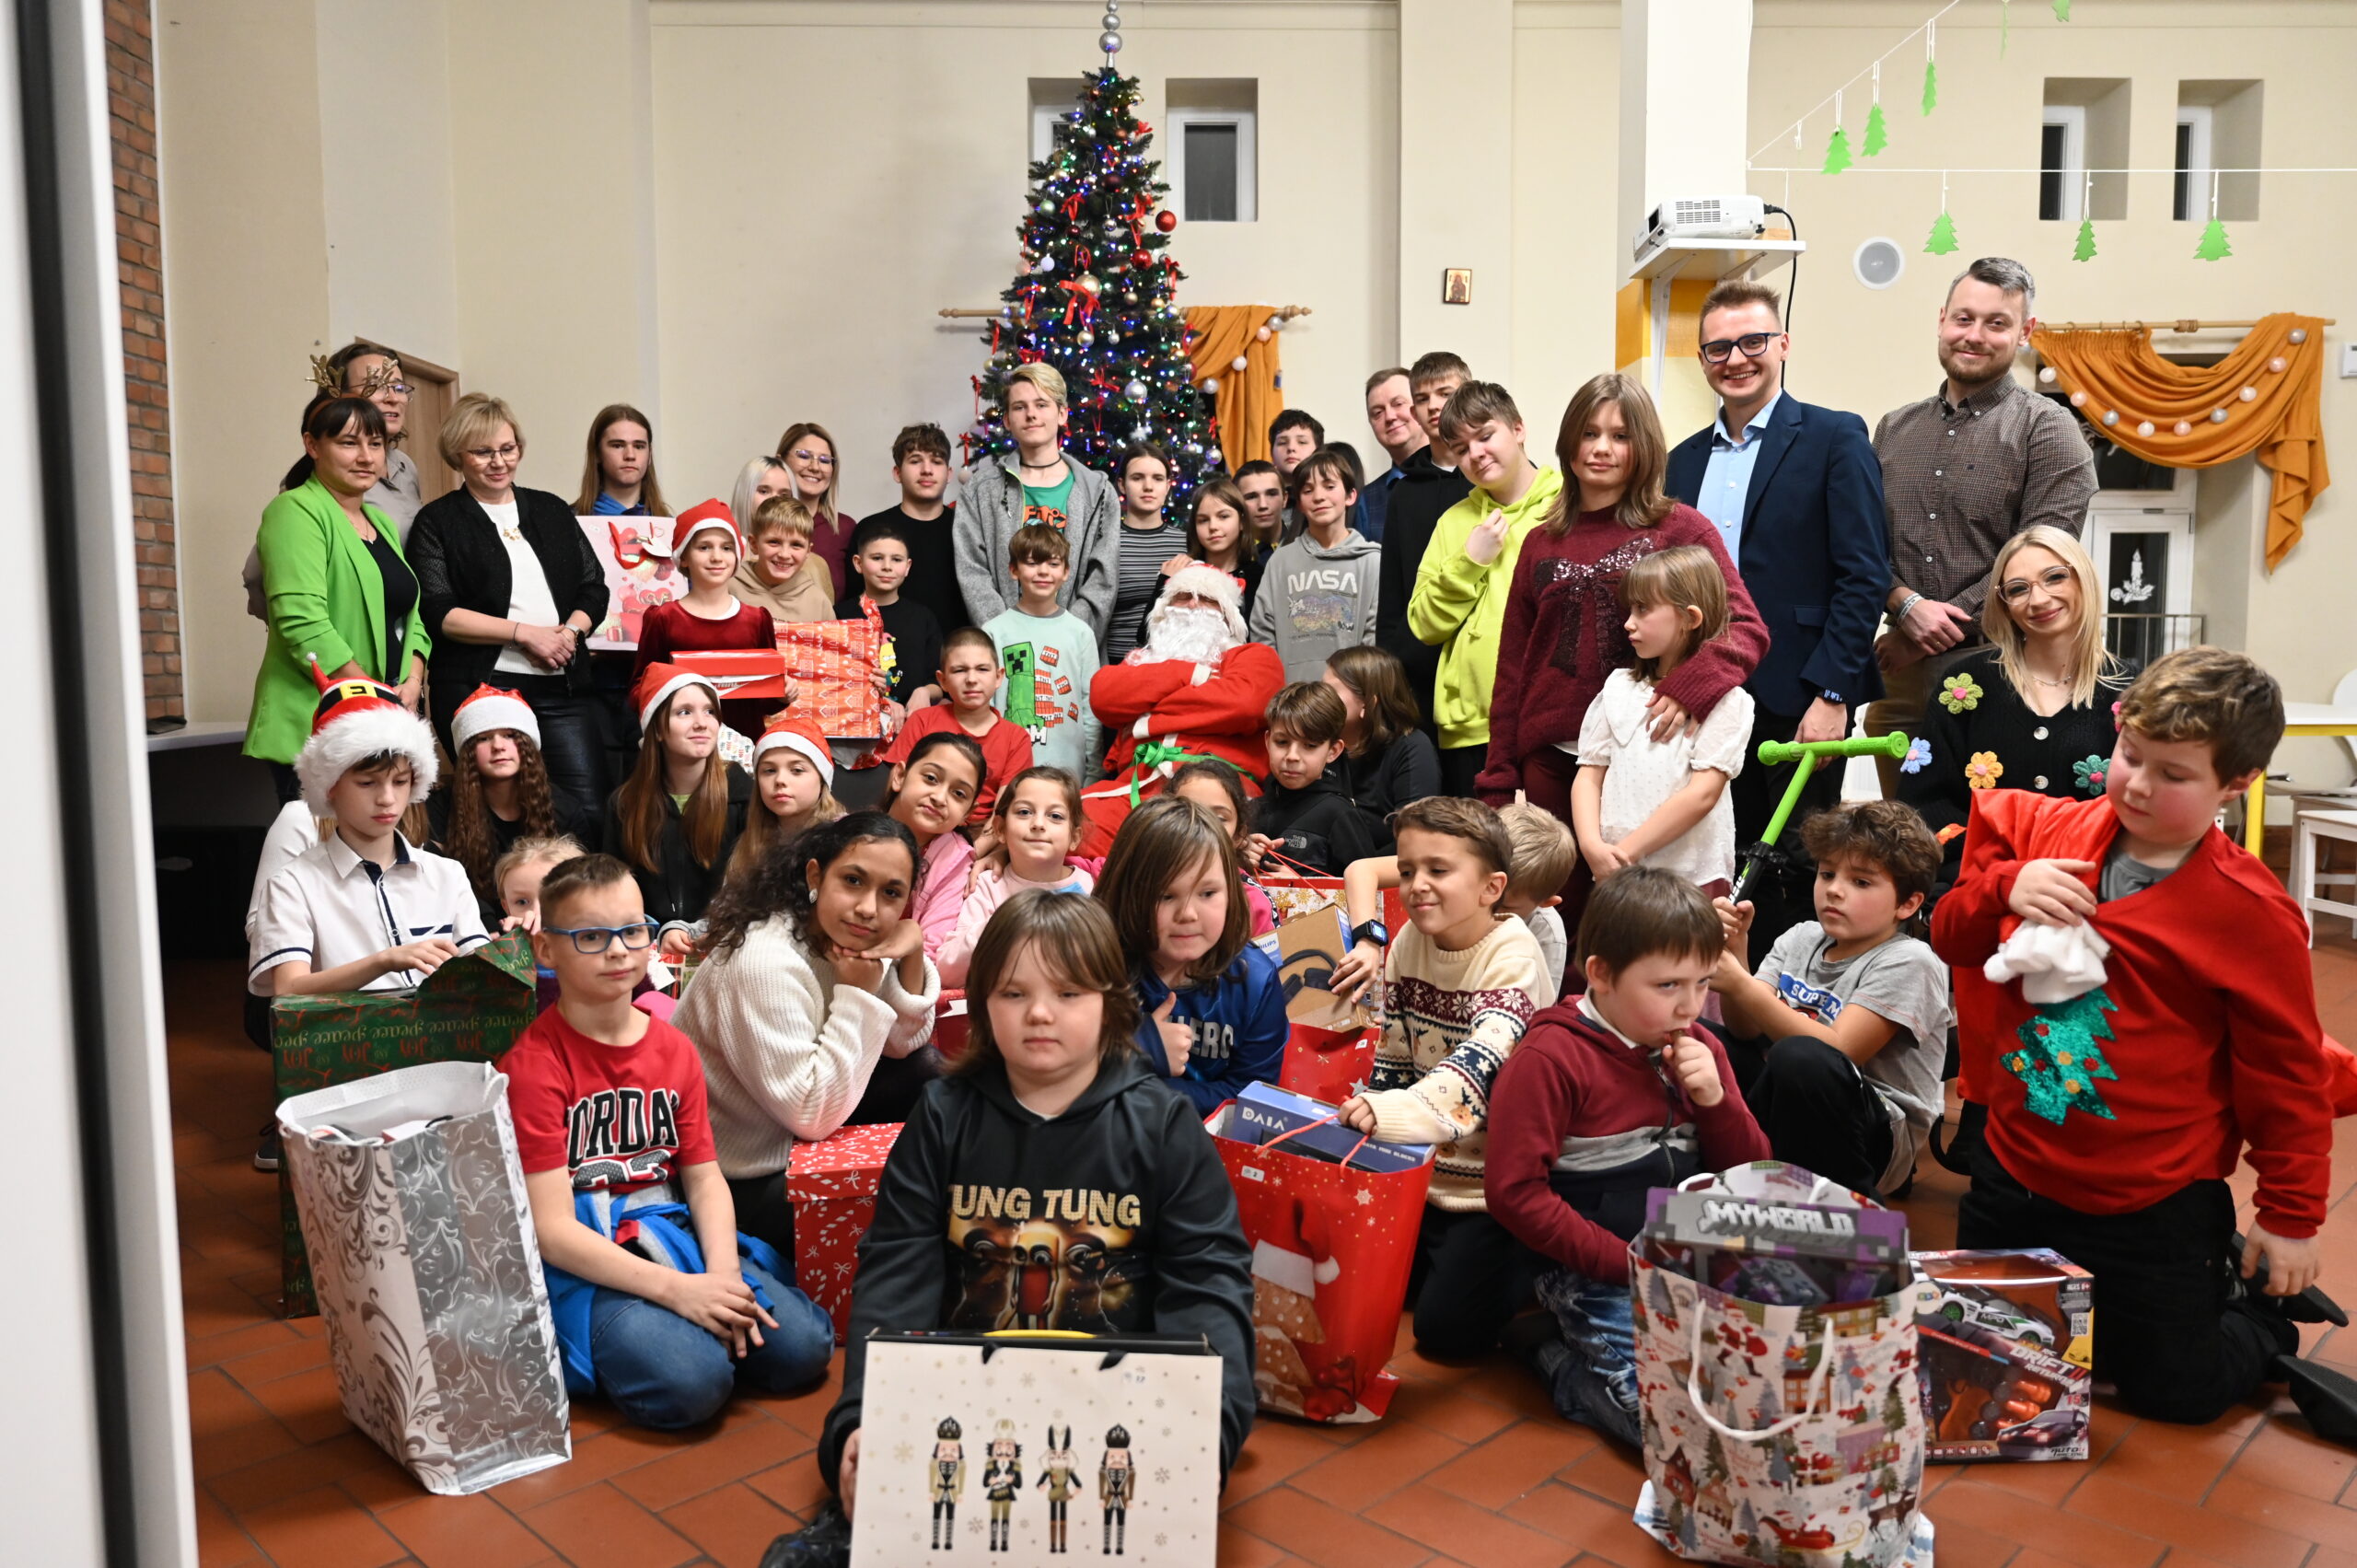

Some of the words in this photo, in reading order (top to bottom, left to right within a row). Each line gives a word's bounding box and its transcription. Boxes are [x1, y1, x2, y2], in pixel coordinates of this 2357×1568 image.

[1287, 569, 1358, 595] NASA
[565, 1087, 679, 1170] ORDA
[949, 1184, 1031, 1220] UNG
[1042, 1188, 1142, 1227] TUNG
[2009, 1345, 2075, 1375] DRIFT
